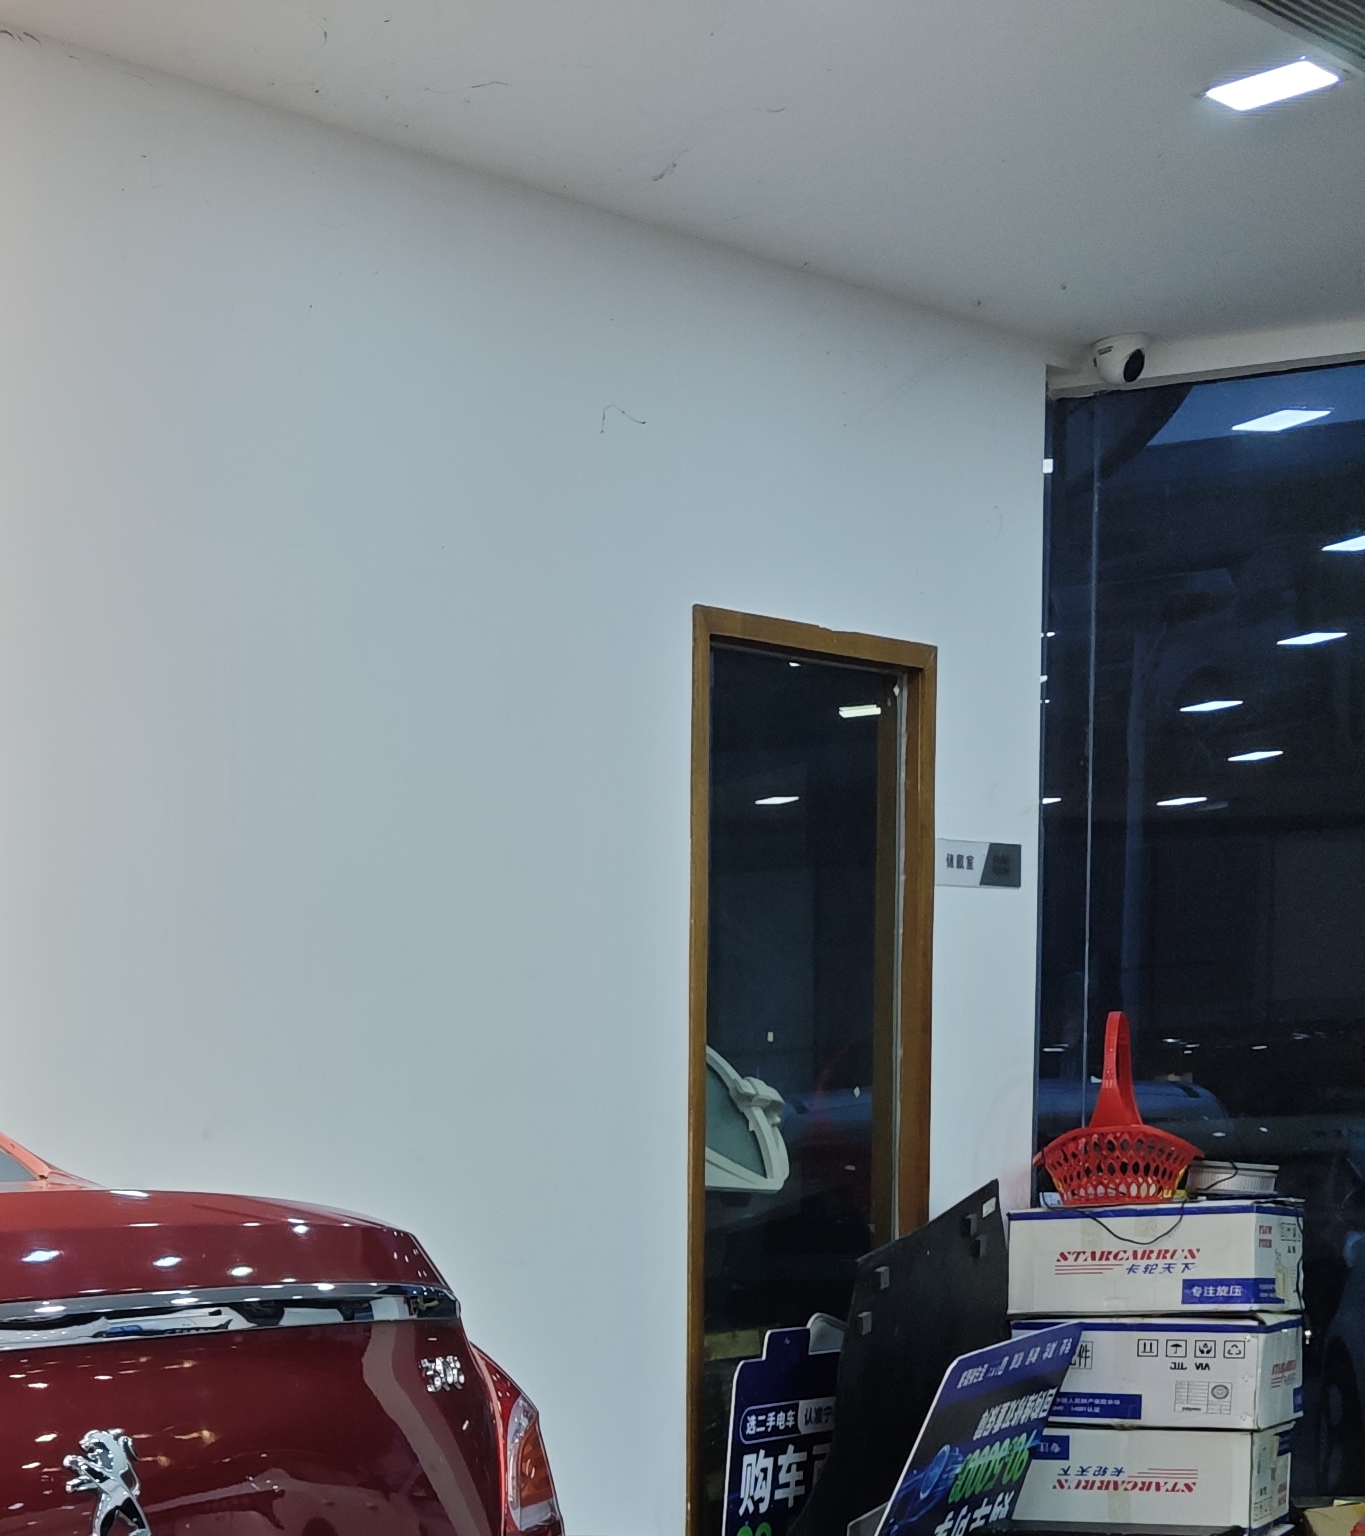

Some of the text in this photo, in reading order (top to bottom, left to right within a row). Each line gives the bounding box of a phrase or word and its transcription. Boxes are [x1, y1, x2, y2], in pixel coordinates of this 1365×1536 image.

[1056, 1247, 1201, 1263] STARCARRUN
[1126, 1262, 1196, 1275] 卡轮天下
[746, 1409, 796, 1435] 选二手电车
